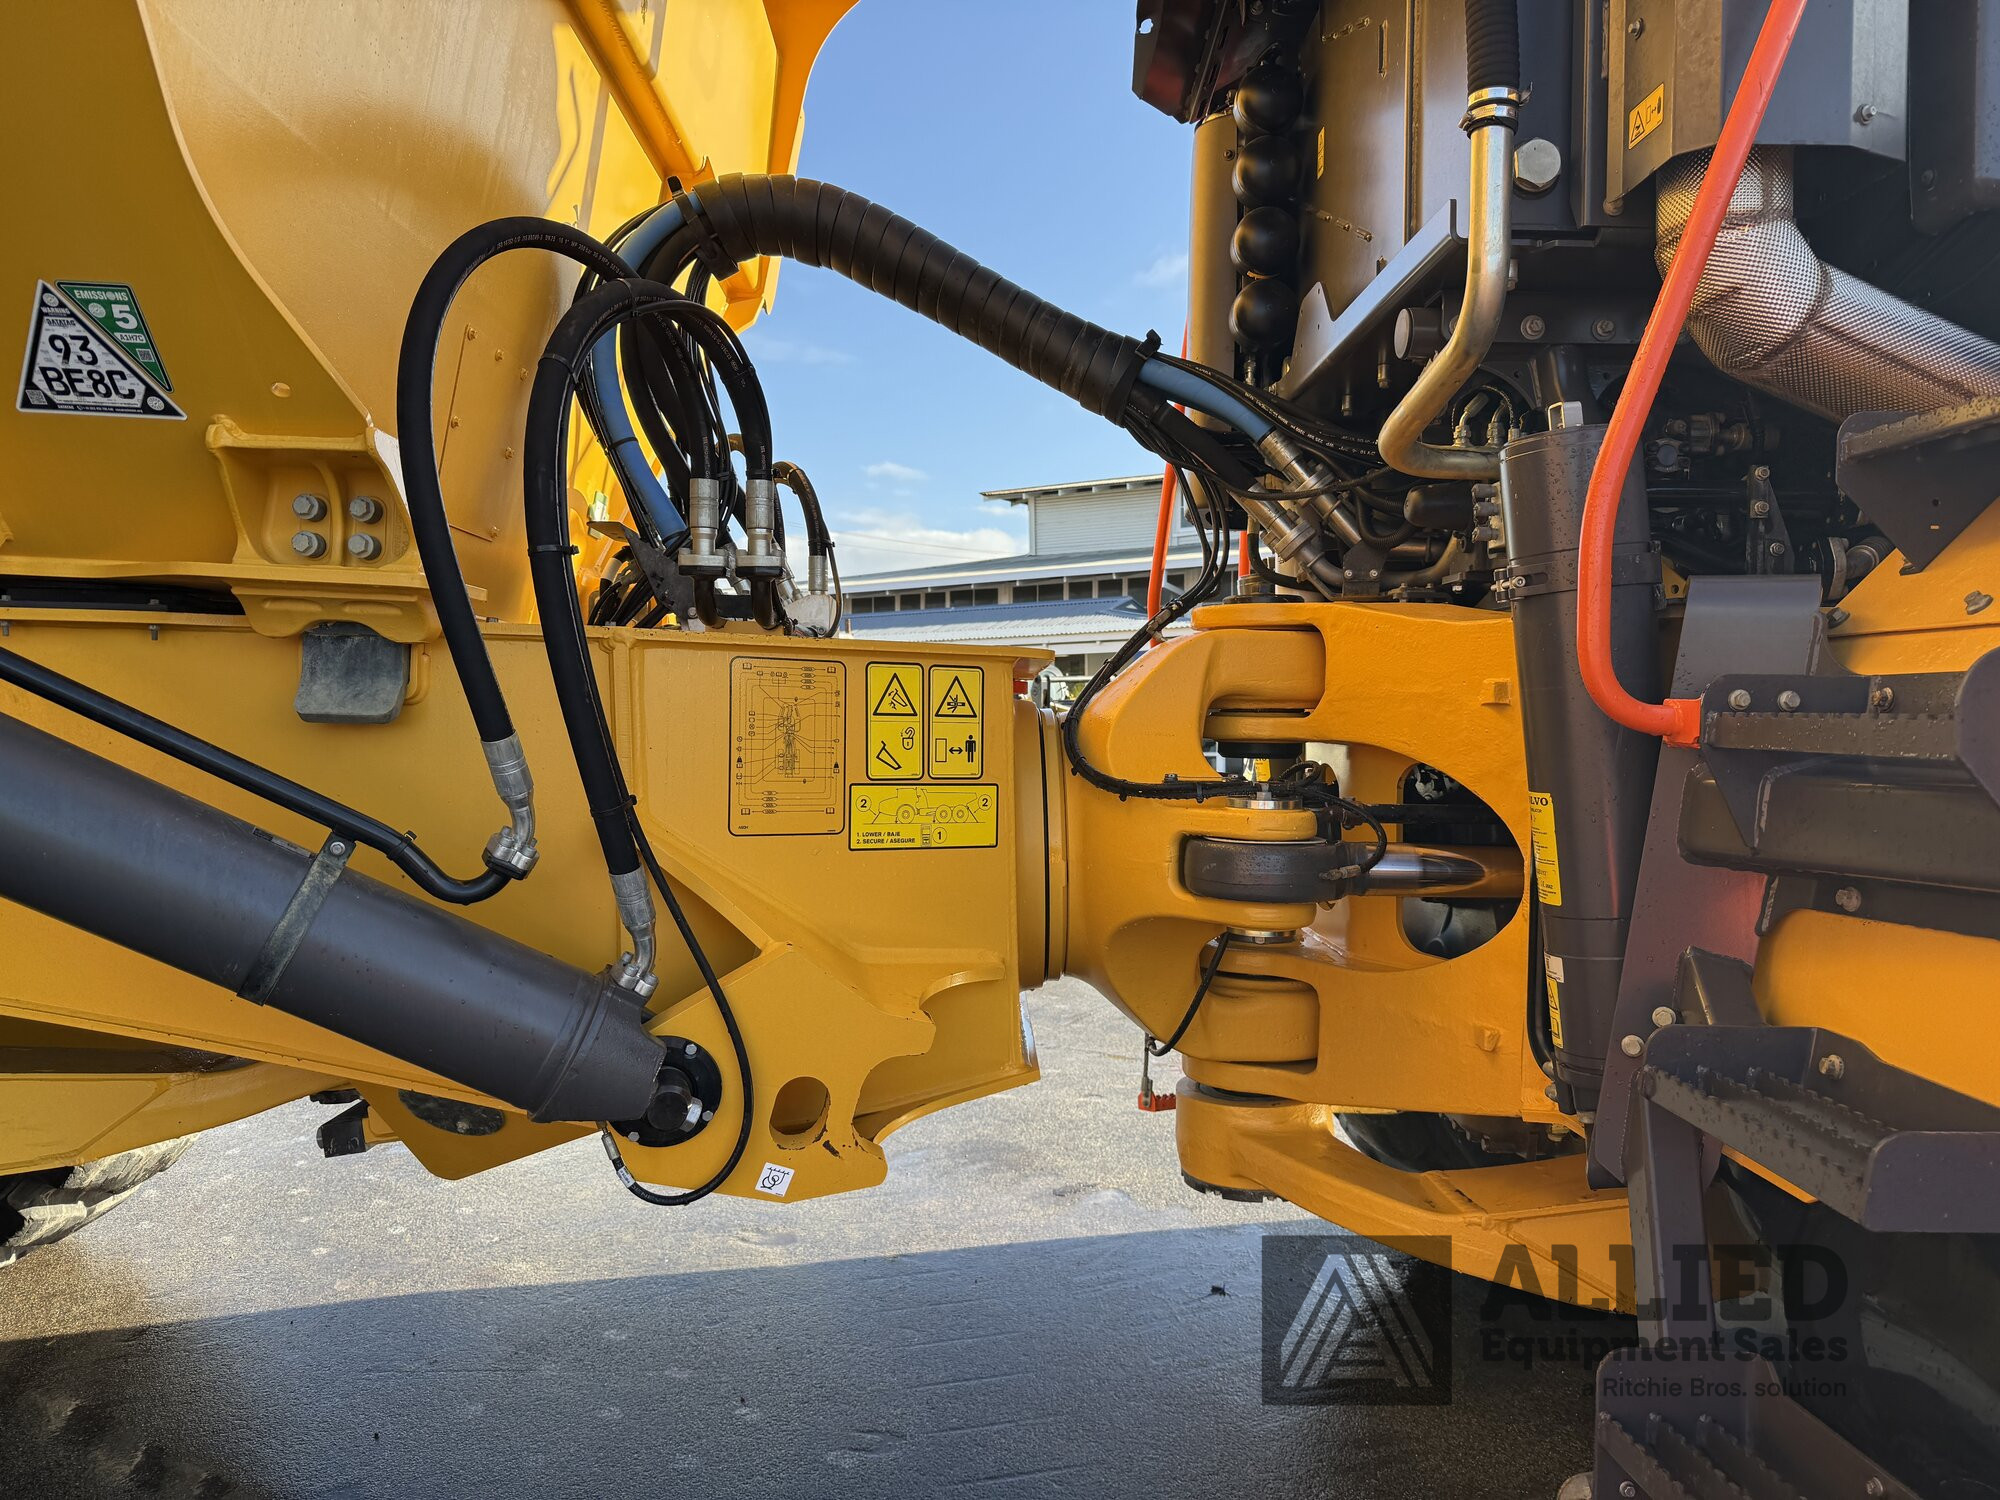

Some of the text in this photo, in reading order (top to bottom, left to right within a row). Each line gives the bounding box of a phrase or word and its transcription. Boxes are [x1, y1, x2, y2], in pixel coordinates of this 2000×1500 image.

[111, 304, 138, 329] 5
[48, 334, 98, 366] 93
[39, 366, 136, 400] BE8C
[860, 799, 867, 808] 2
[982, 798, 989, 807] 2
[1529, 796, 1549, 806] LVO
[937, 831, 942, 840] 1
